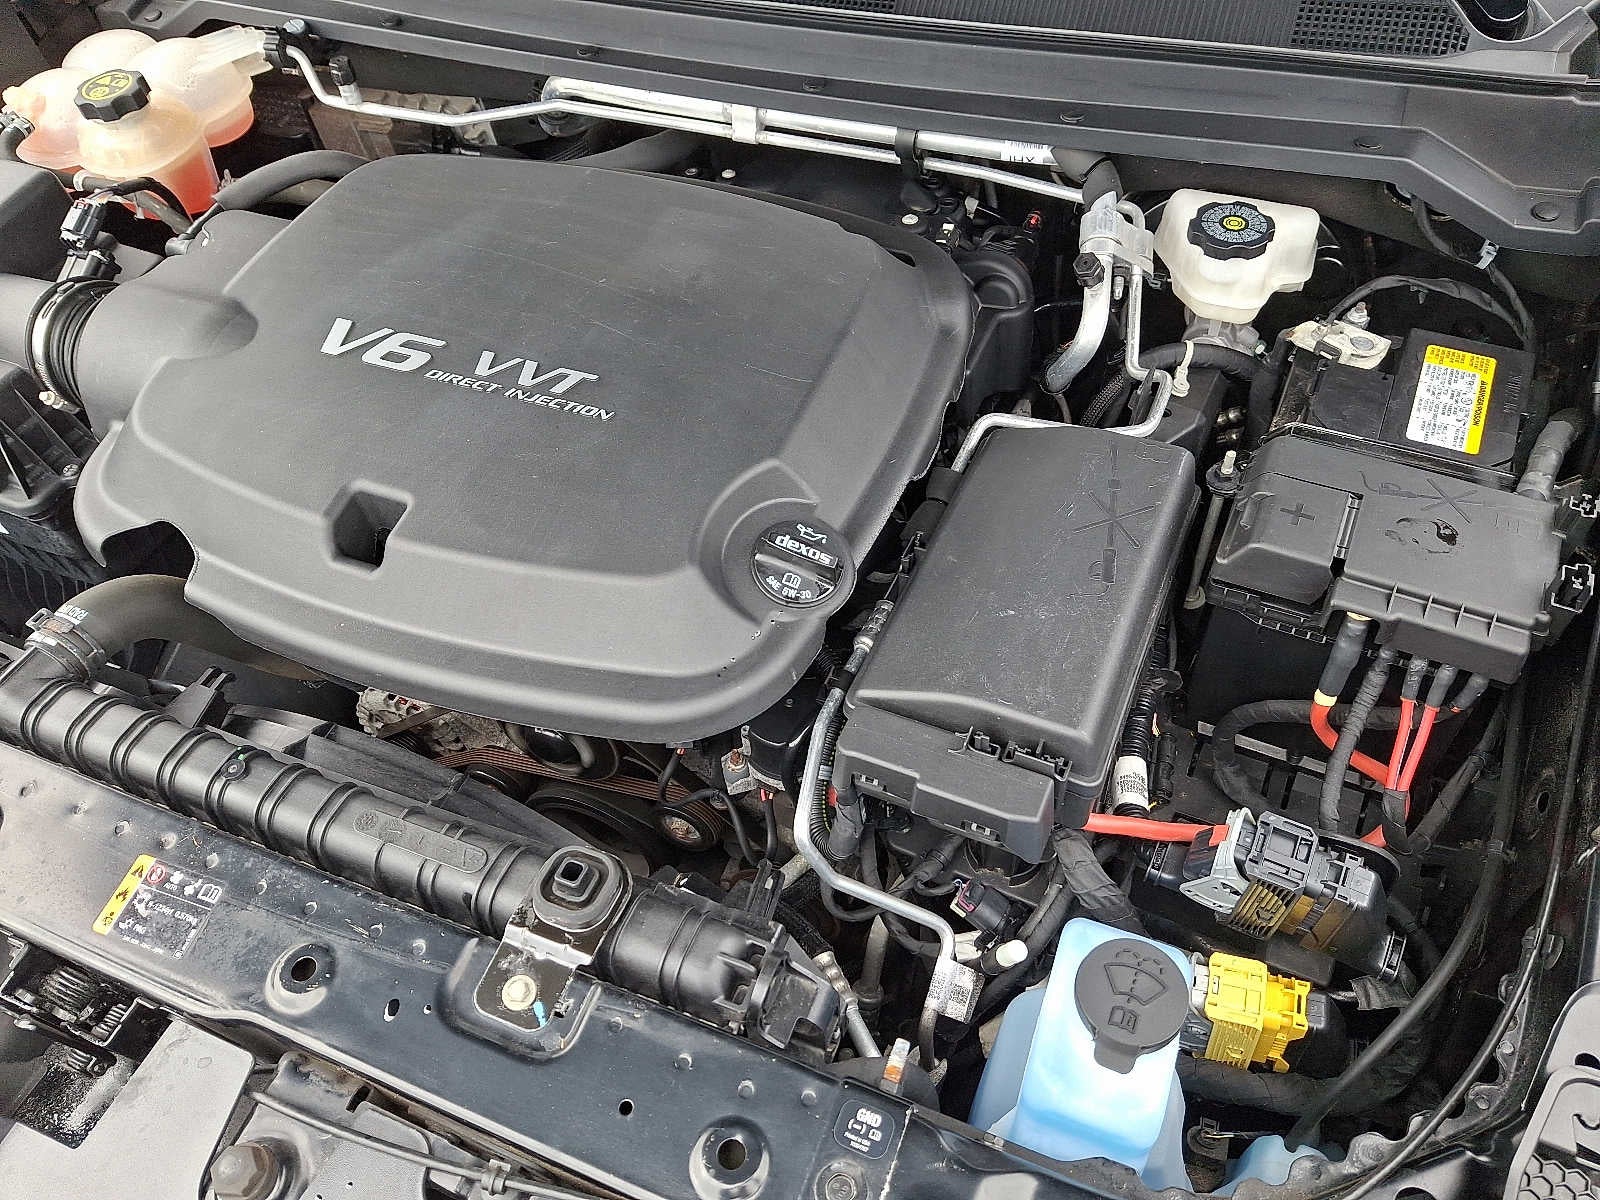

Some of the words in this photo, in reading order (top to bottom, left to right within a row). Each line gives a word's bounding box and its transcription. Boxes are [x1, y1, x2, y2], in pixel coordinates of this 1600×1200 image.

[320, 317, 447, 372] V6
[474, 350, 600, 395] VVT
[424, 369, 503, 393] DIRECT
[503, 387, 616, 422] INJECTION
[774, 534, 834, 565] dexos
[766, 575, 782, 591] SAE
[781, 587, 812, 599] 5W-30
